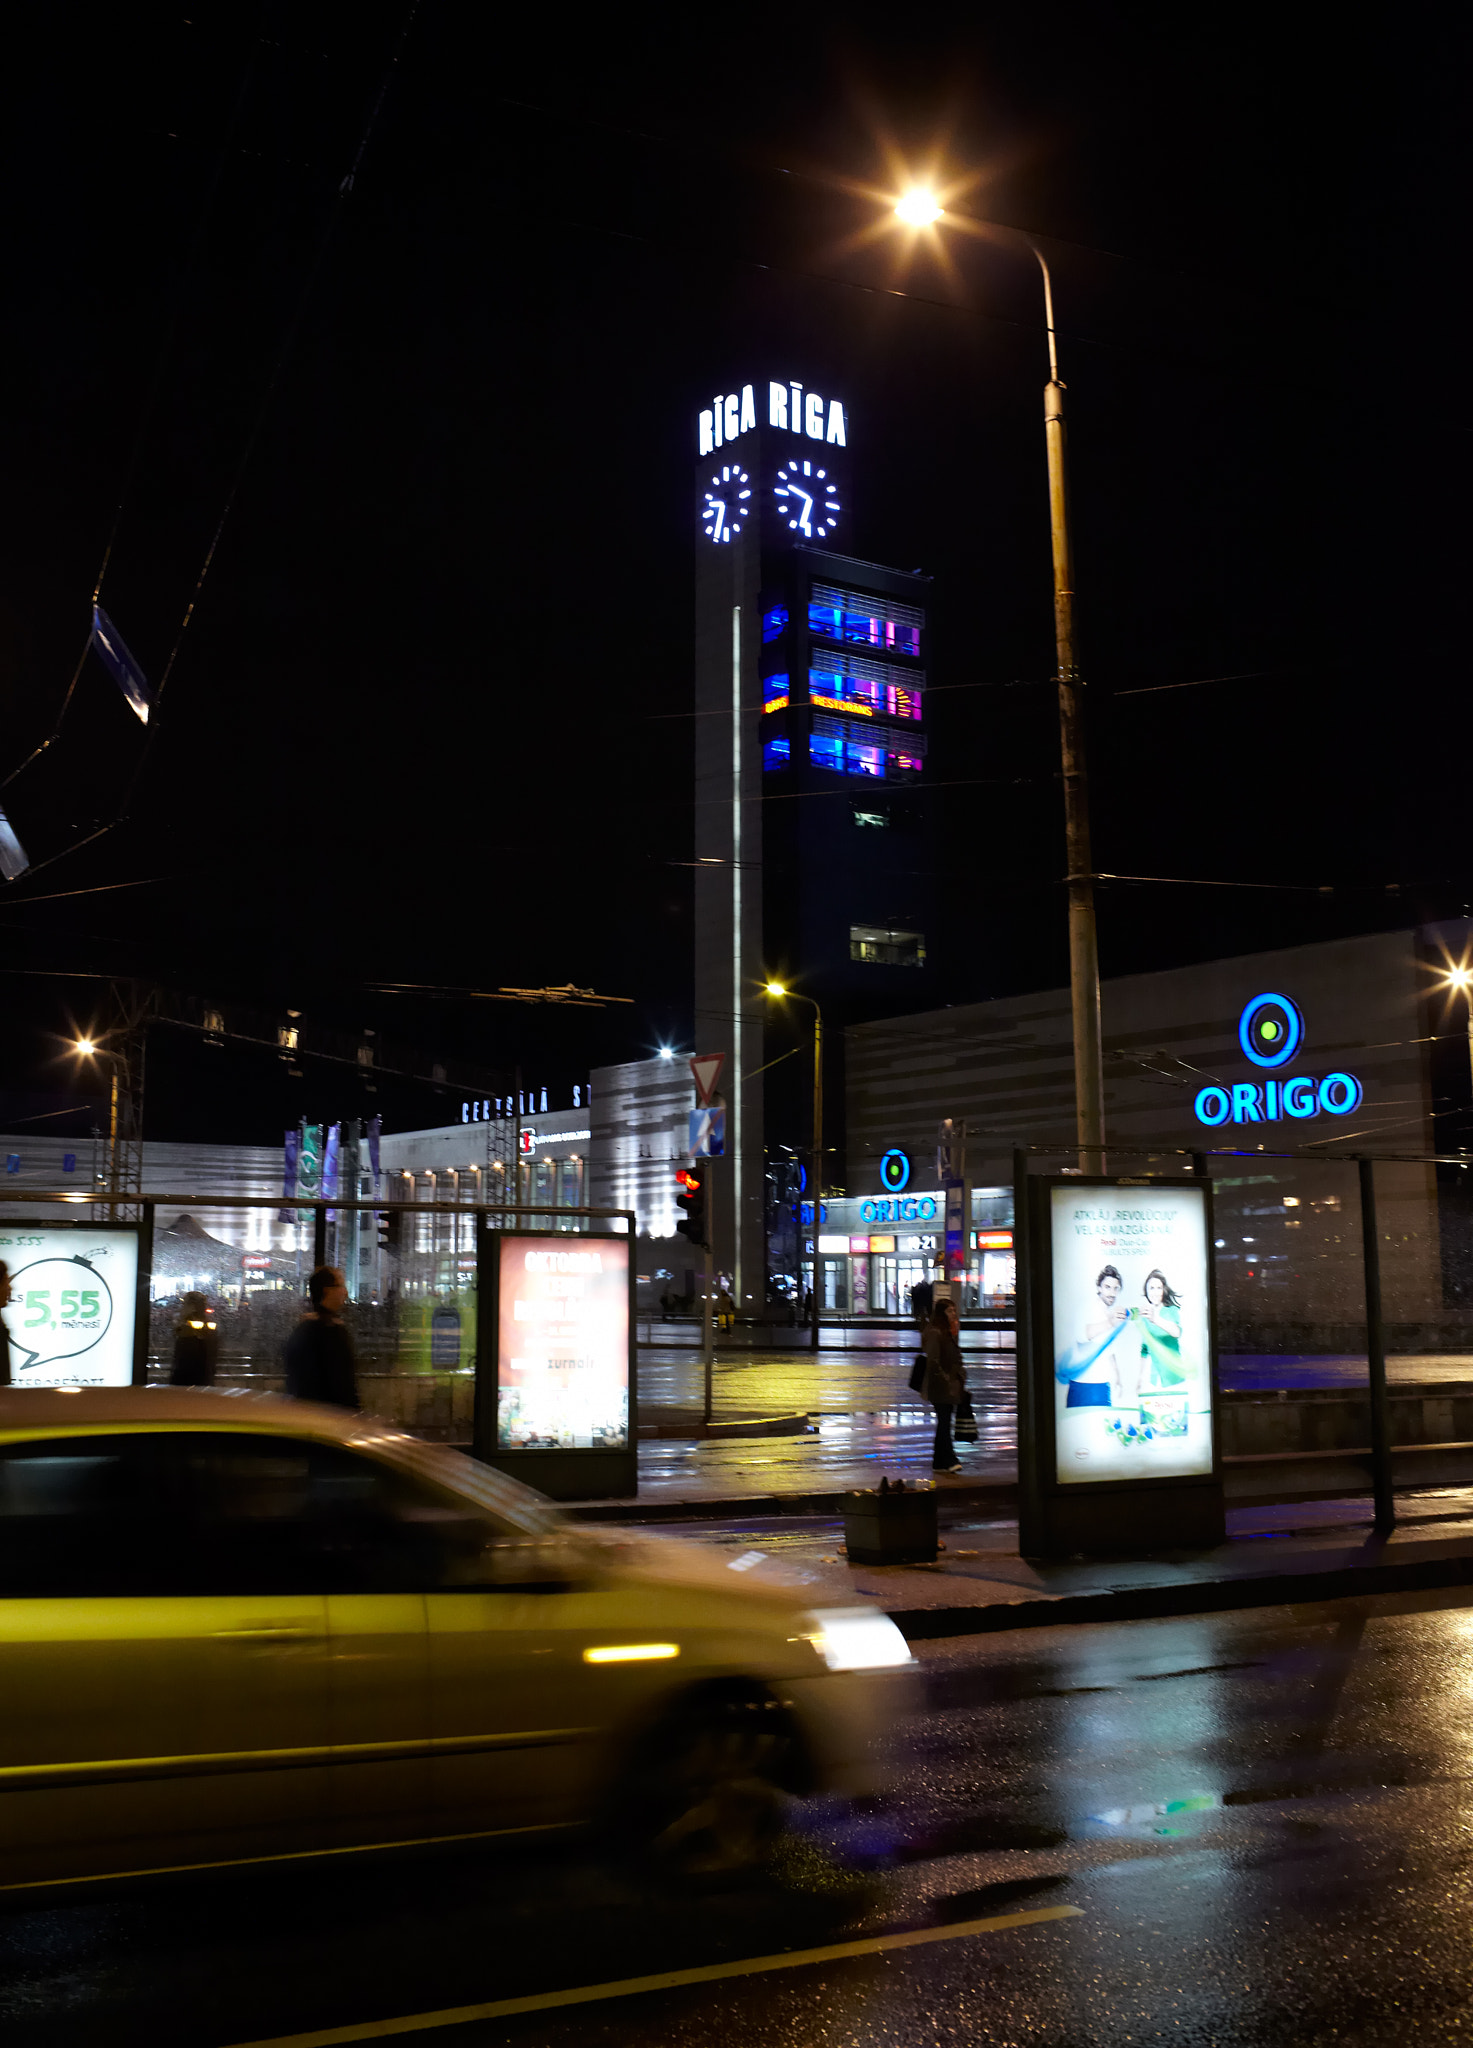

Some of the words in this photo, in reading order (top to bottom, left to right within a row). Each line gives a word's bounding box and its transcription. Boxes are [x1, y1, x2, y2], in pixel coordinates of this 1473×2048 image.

[699, 384, 756, 456] RĪGA
[769, 380, 847, 447] RĪGA
[1194, 1072, 1362, 1127] ORIGO
[860, 1197, 937, 1224] ORIGO
[24, 1290, 100, 1330] 5,55
